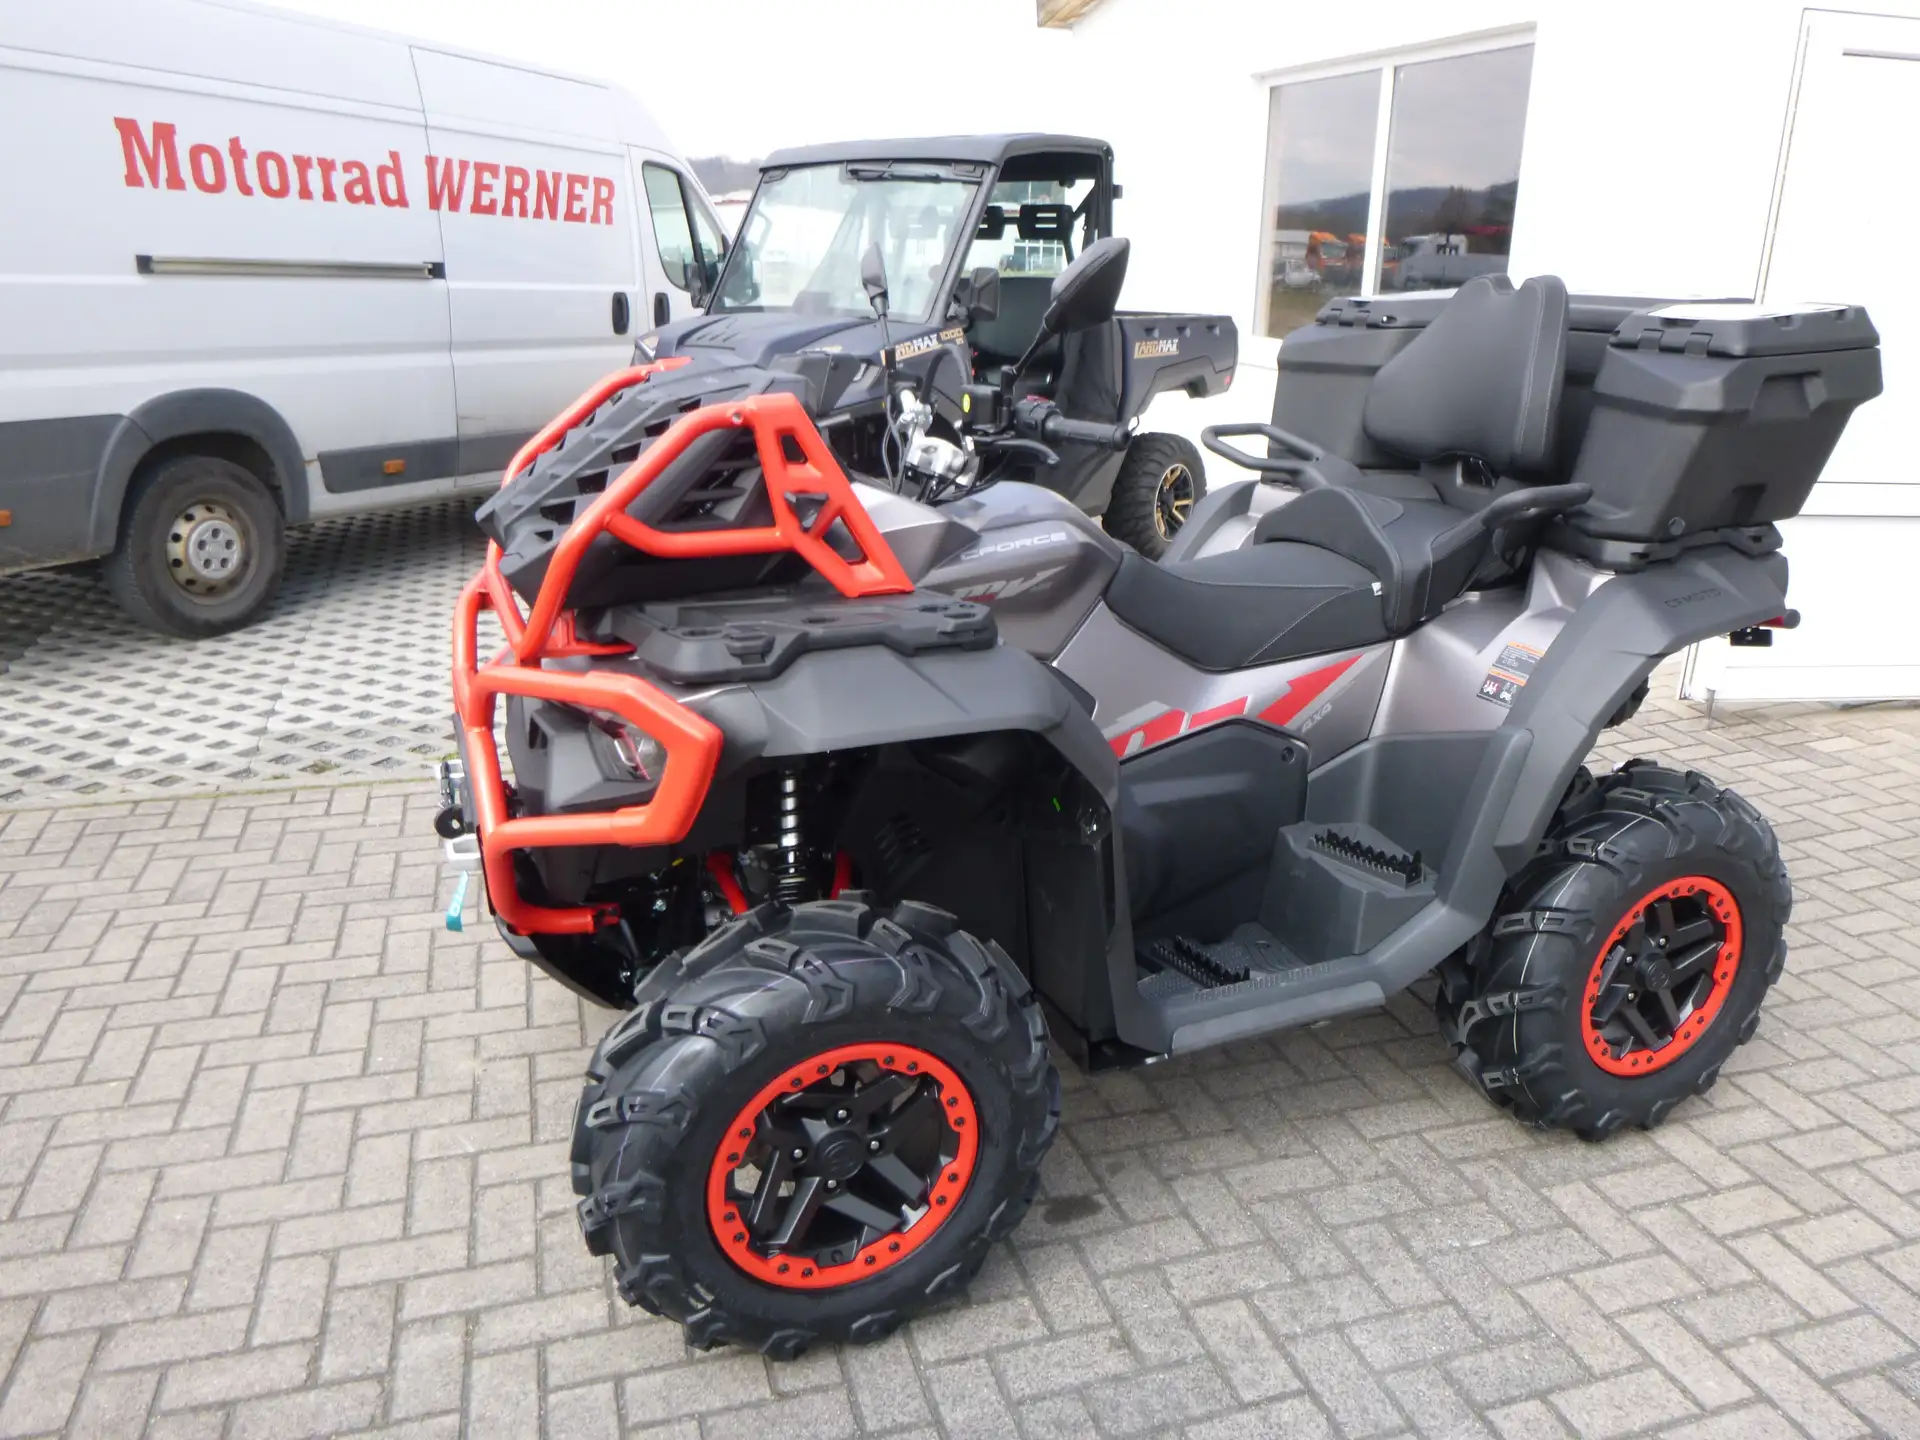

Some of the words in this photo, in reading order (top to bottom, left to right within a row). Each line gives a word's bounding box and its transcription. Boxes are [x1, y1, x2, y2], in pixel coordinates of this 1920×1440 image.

[113, 116, 409, 209] Motorrad
[425, 154, 616, 226] WERNER
[880, 333, 942, 366] LNDMAX
[1134, 337, 1180, 359] LANDMAX
[961, 531, 1067, 561] CFORCE
